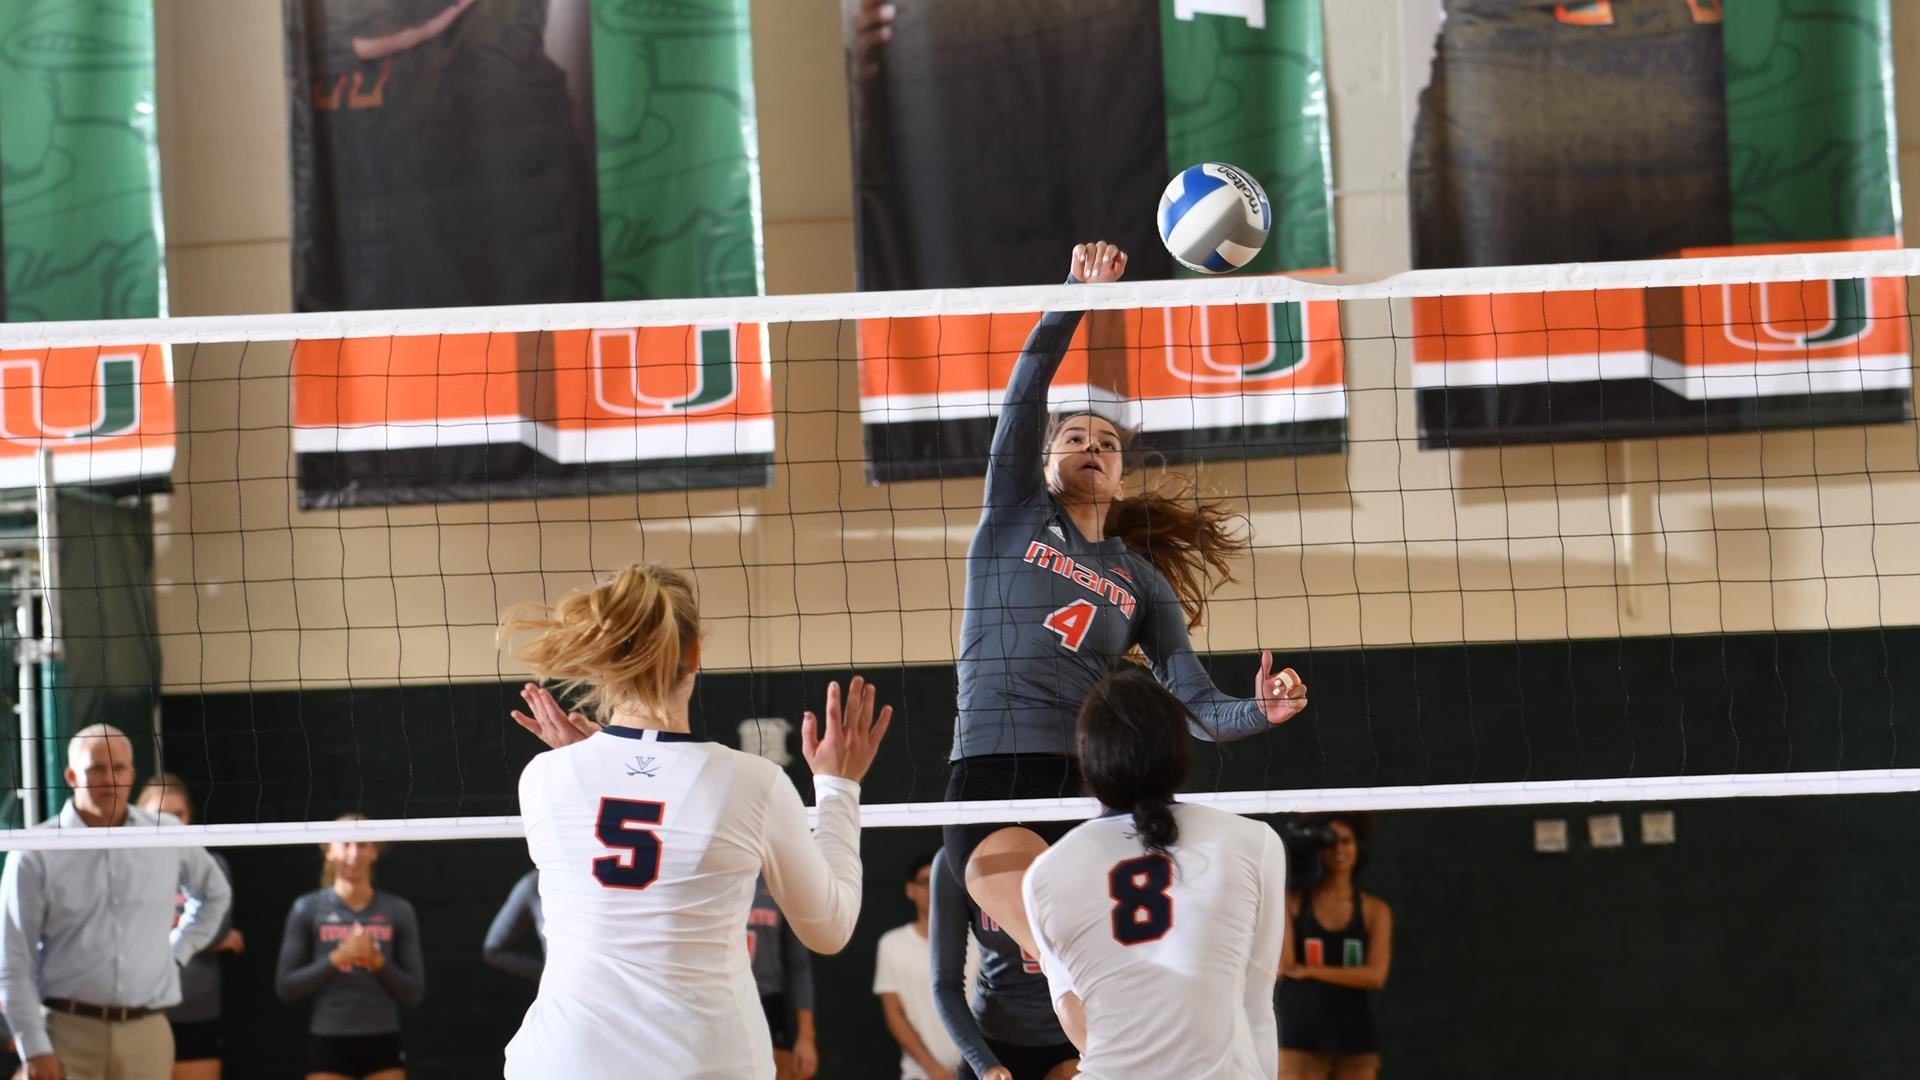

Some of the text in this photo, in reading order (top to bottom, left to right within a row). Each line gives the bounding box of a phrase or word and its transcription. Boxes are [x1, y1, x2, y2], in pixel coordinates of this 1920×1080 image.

[1217, 166, 1260, 215] molten
[1164, 302, 1310, 383] U
[1722, 278, 1874, 351] U
[0, 354, 141, 446] U
[593, 324, 740, 416] U
[1043, 598, 1097, 652] 4
[592, 796, 665, 891] 5
[1108, 852, 1174, 947] 8
